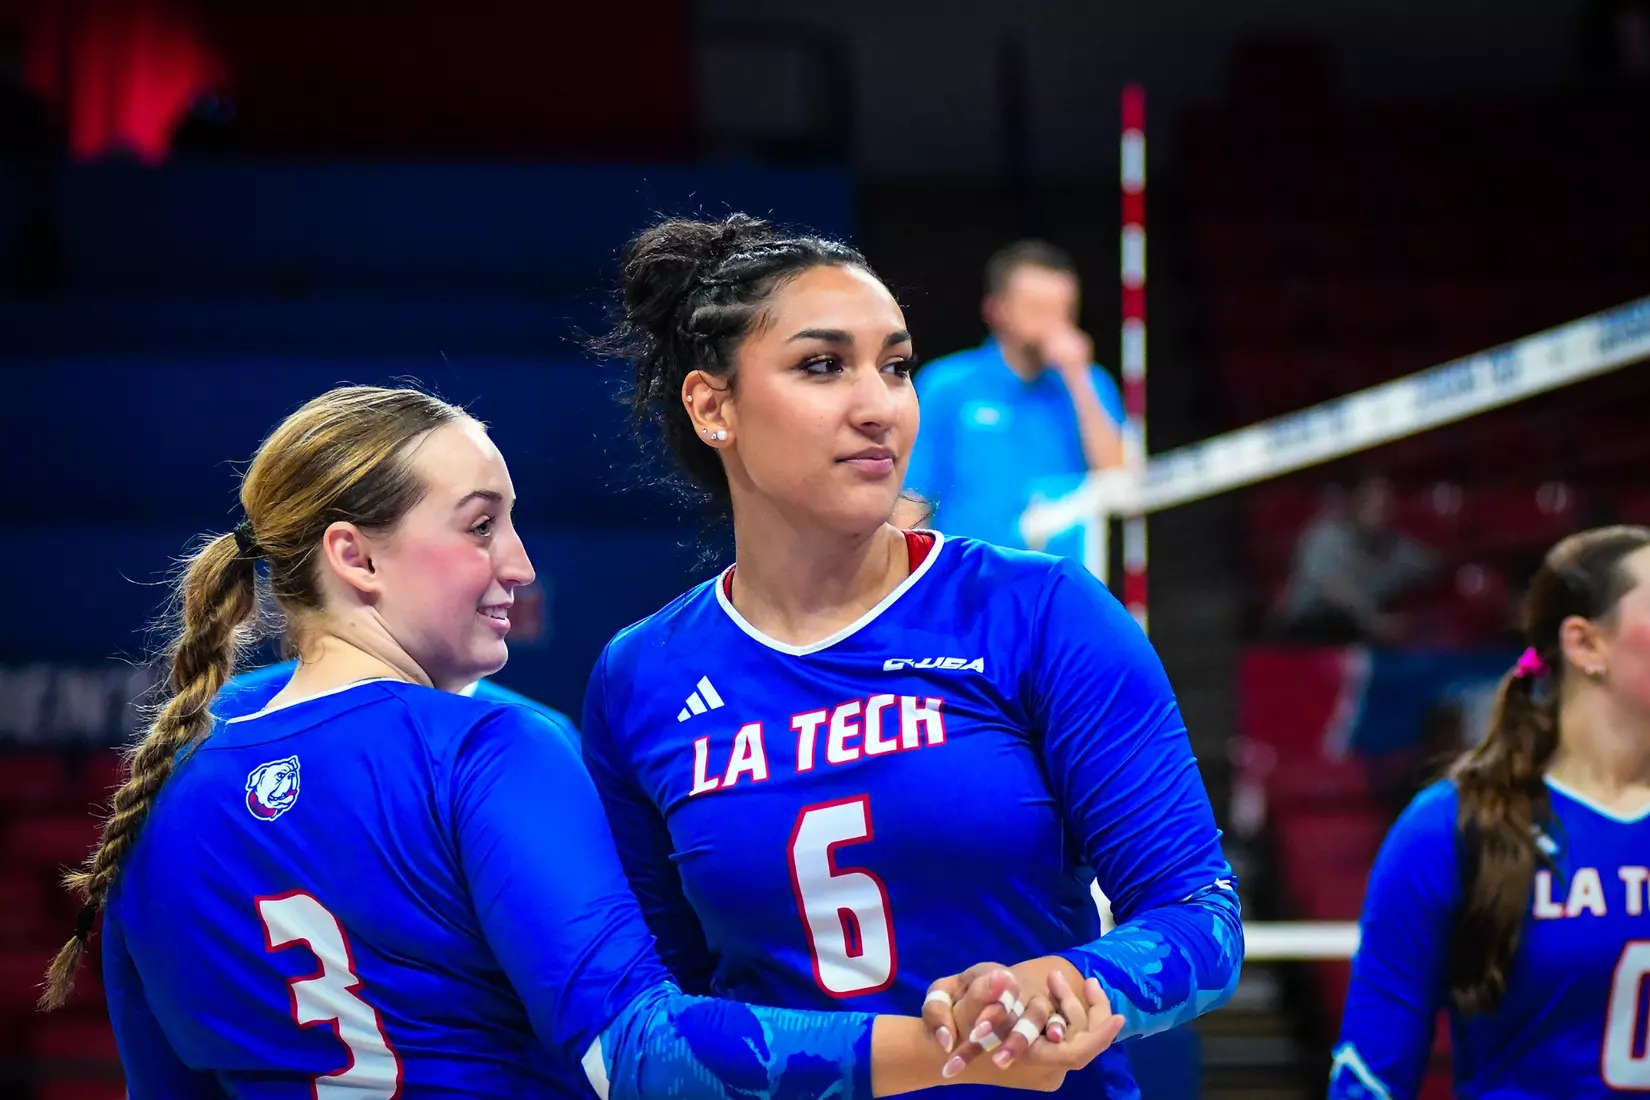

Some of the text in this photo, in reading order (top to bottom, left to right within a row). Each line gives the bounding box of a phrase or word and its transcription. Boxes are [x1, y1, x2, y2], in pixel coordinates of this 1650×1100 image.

[690, 694, 945, 795] LA TECH
[788, 794, 897, 998] 6
[1534, 866, 1650, 918] LA T
[254, 889, 403, 1100] 3
